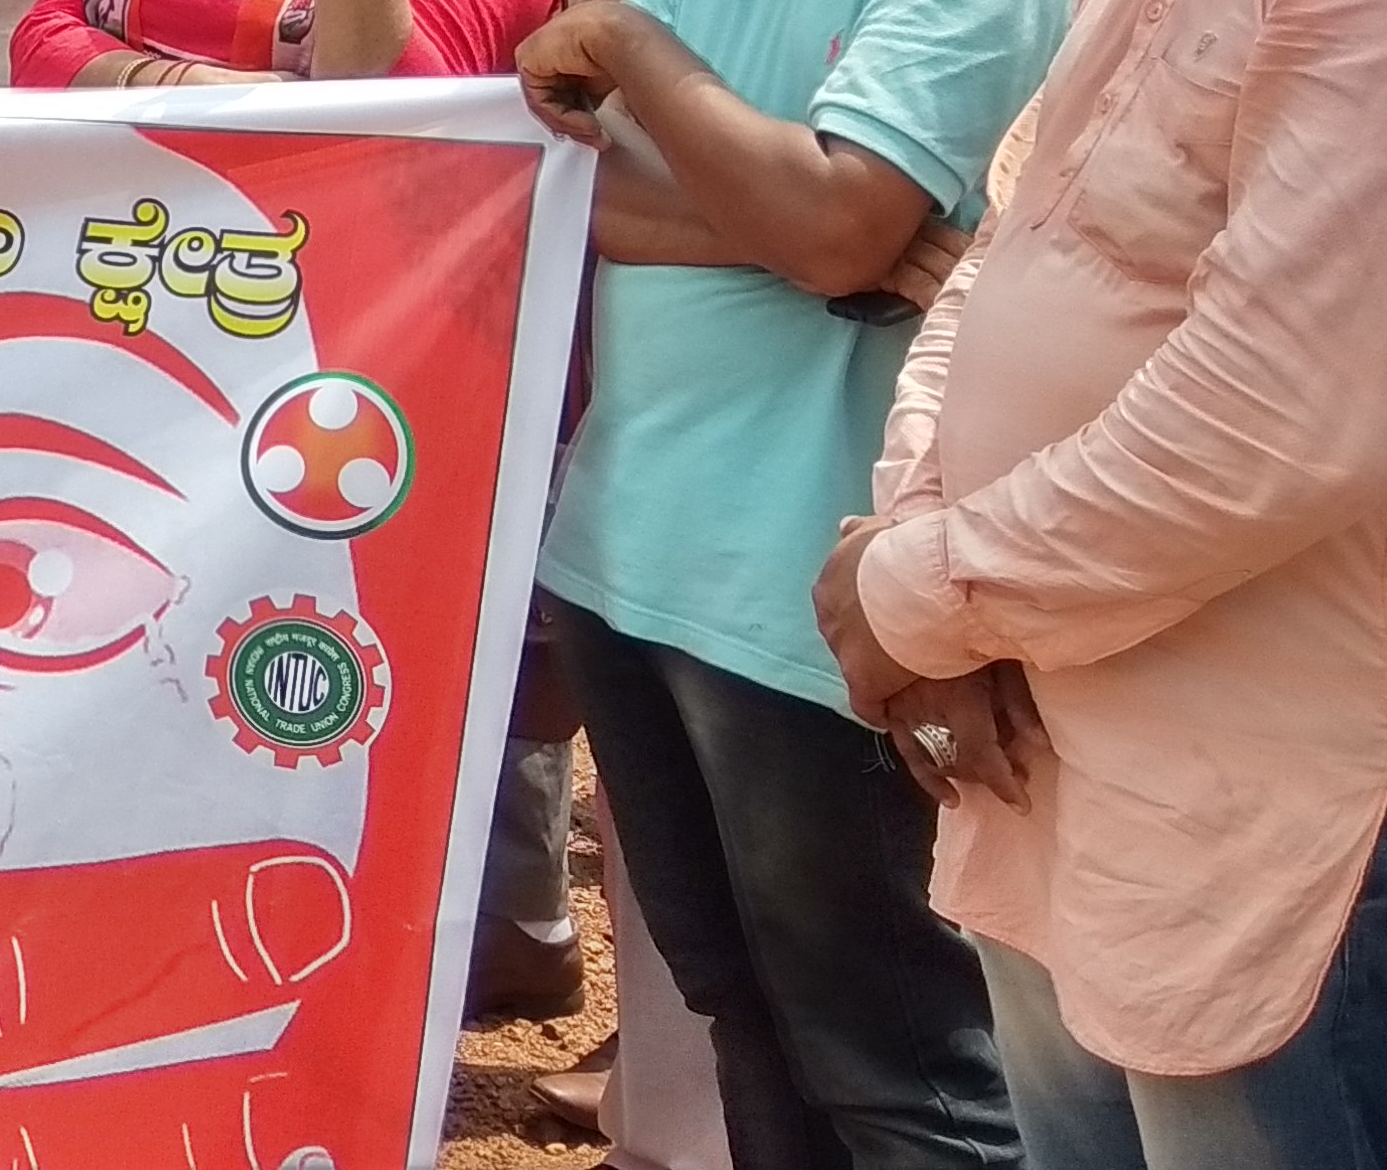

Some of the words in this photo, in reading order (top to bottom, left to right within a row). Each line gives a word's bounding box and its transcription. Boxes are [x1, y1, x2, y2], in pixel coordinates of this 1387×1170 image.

[75, 198, 310, 339] ಕ್ಷೇತ್ರ
[267, 652, 328, 712] INTUC
[275, 718, 307, 734] TRADE
[310, 711, 340, 733] UNION
[336, 661, 353, 713] CONGRESS
